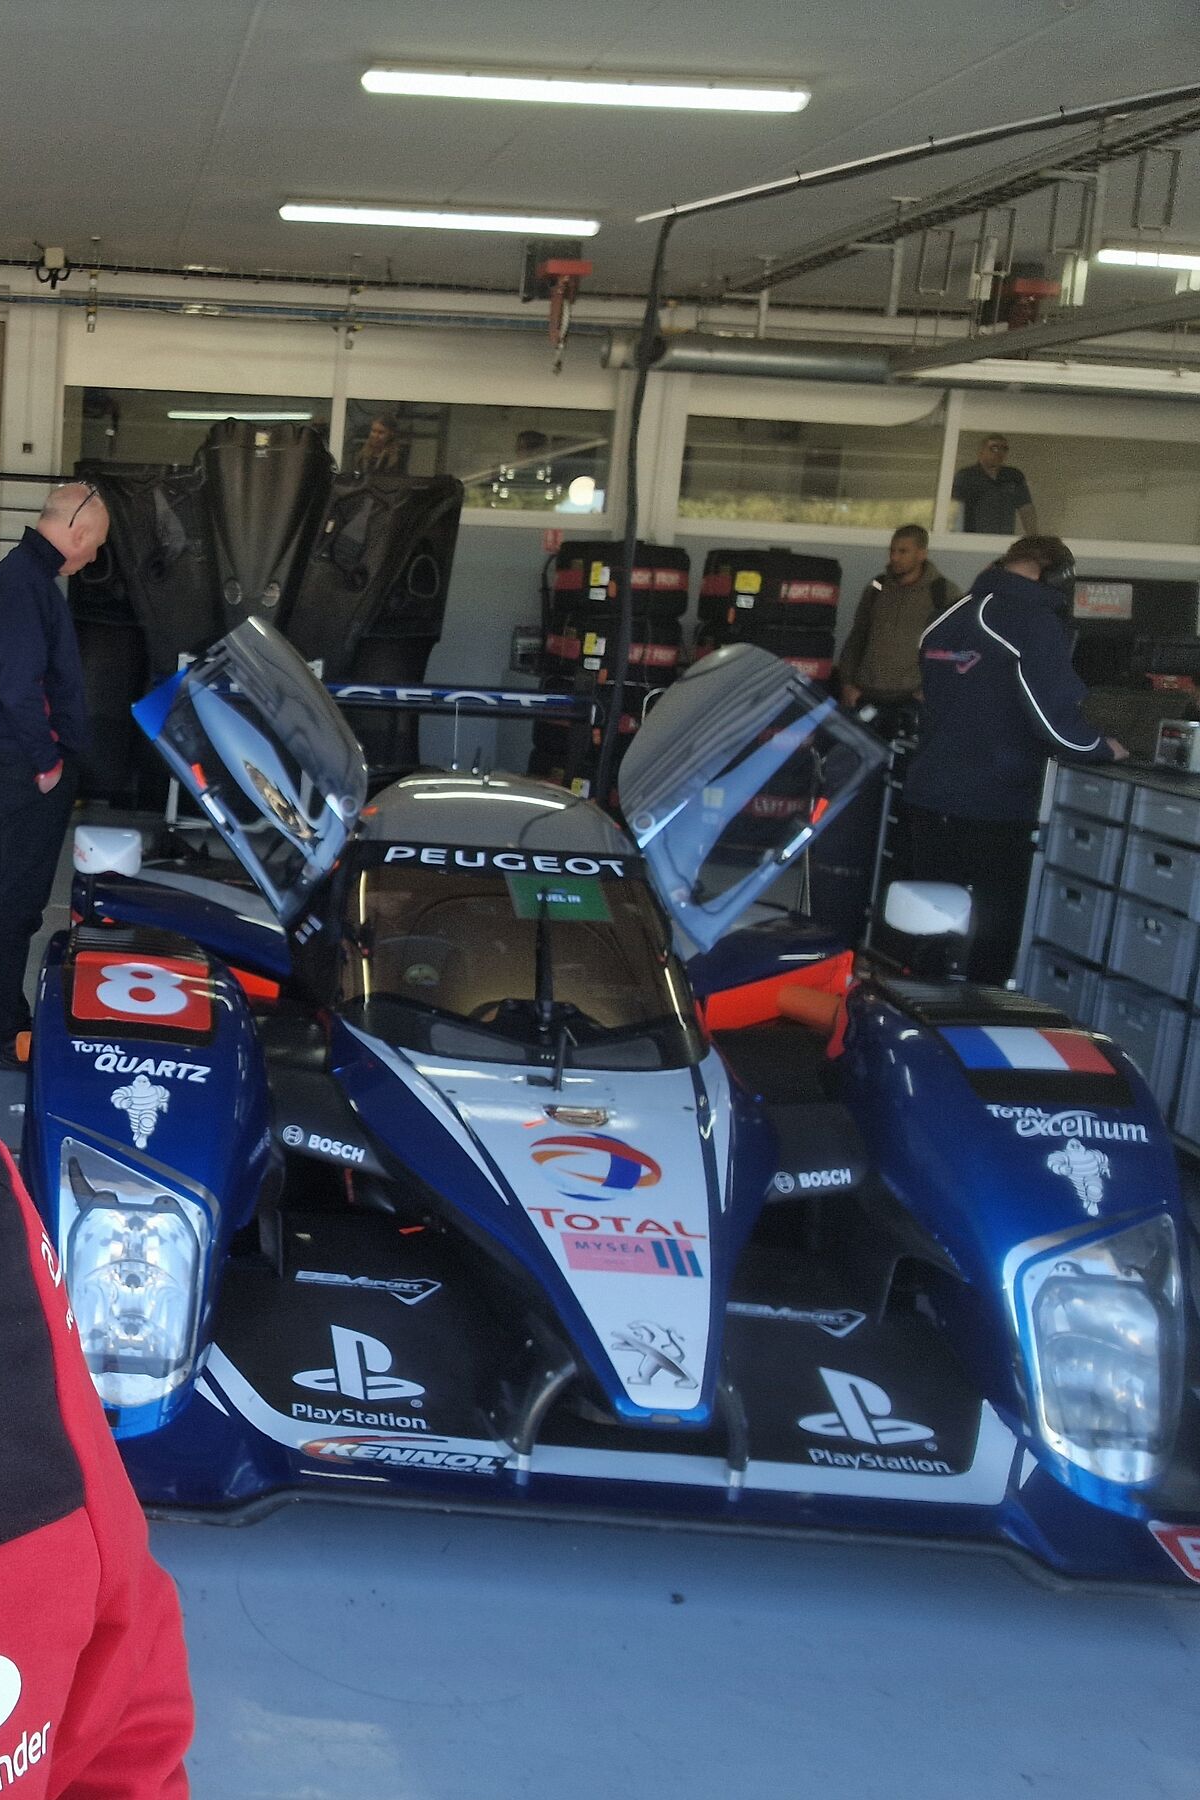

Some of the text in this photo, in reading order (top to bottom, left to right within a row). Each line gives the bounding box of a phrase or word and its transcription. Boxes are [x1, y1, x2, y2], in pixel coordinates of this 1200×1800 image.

[383, 846, 625, 878] PEUGEOT
[96, 962, 189, 1016] 8
[70, 1040, 126, 1055] TOTAL
[94, 1053, 211, 1083] QUARTZ
[986, 1103, 1051, 1119] TOTAL
[308, 1134, 366, 1163] BOSCH
[798, 1167, 852, 1189] BOSCH
[527, 1207, 707, 1239] TOTAL
[575, 1240, 645, 1253] MYSEA
[291, 1403, 427, 1430] PlayStation
[319, 1443, 497, 1469] KENNOL
[808, 1448, 952, 1474] PlayStation
